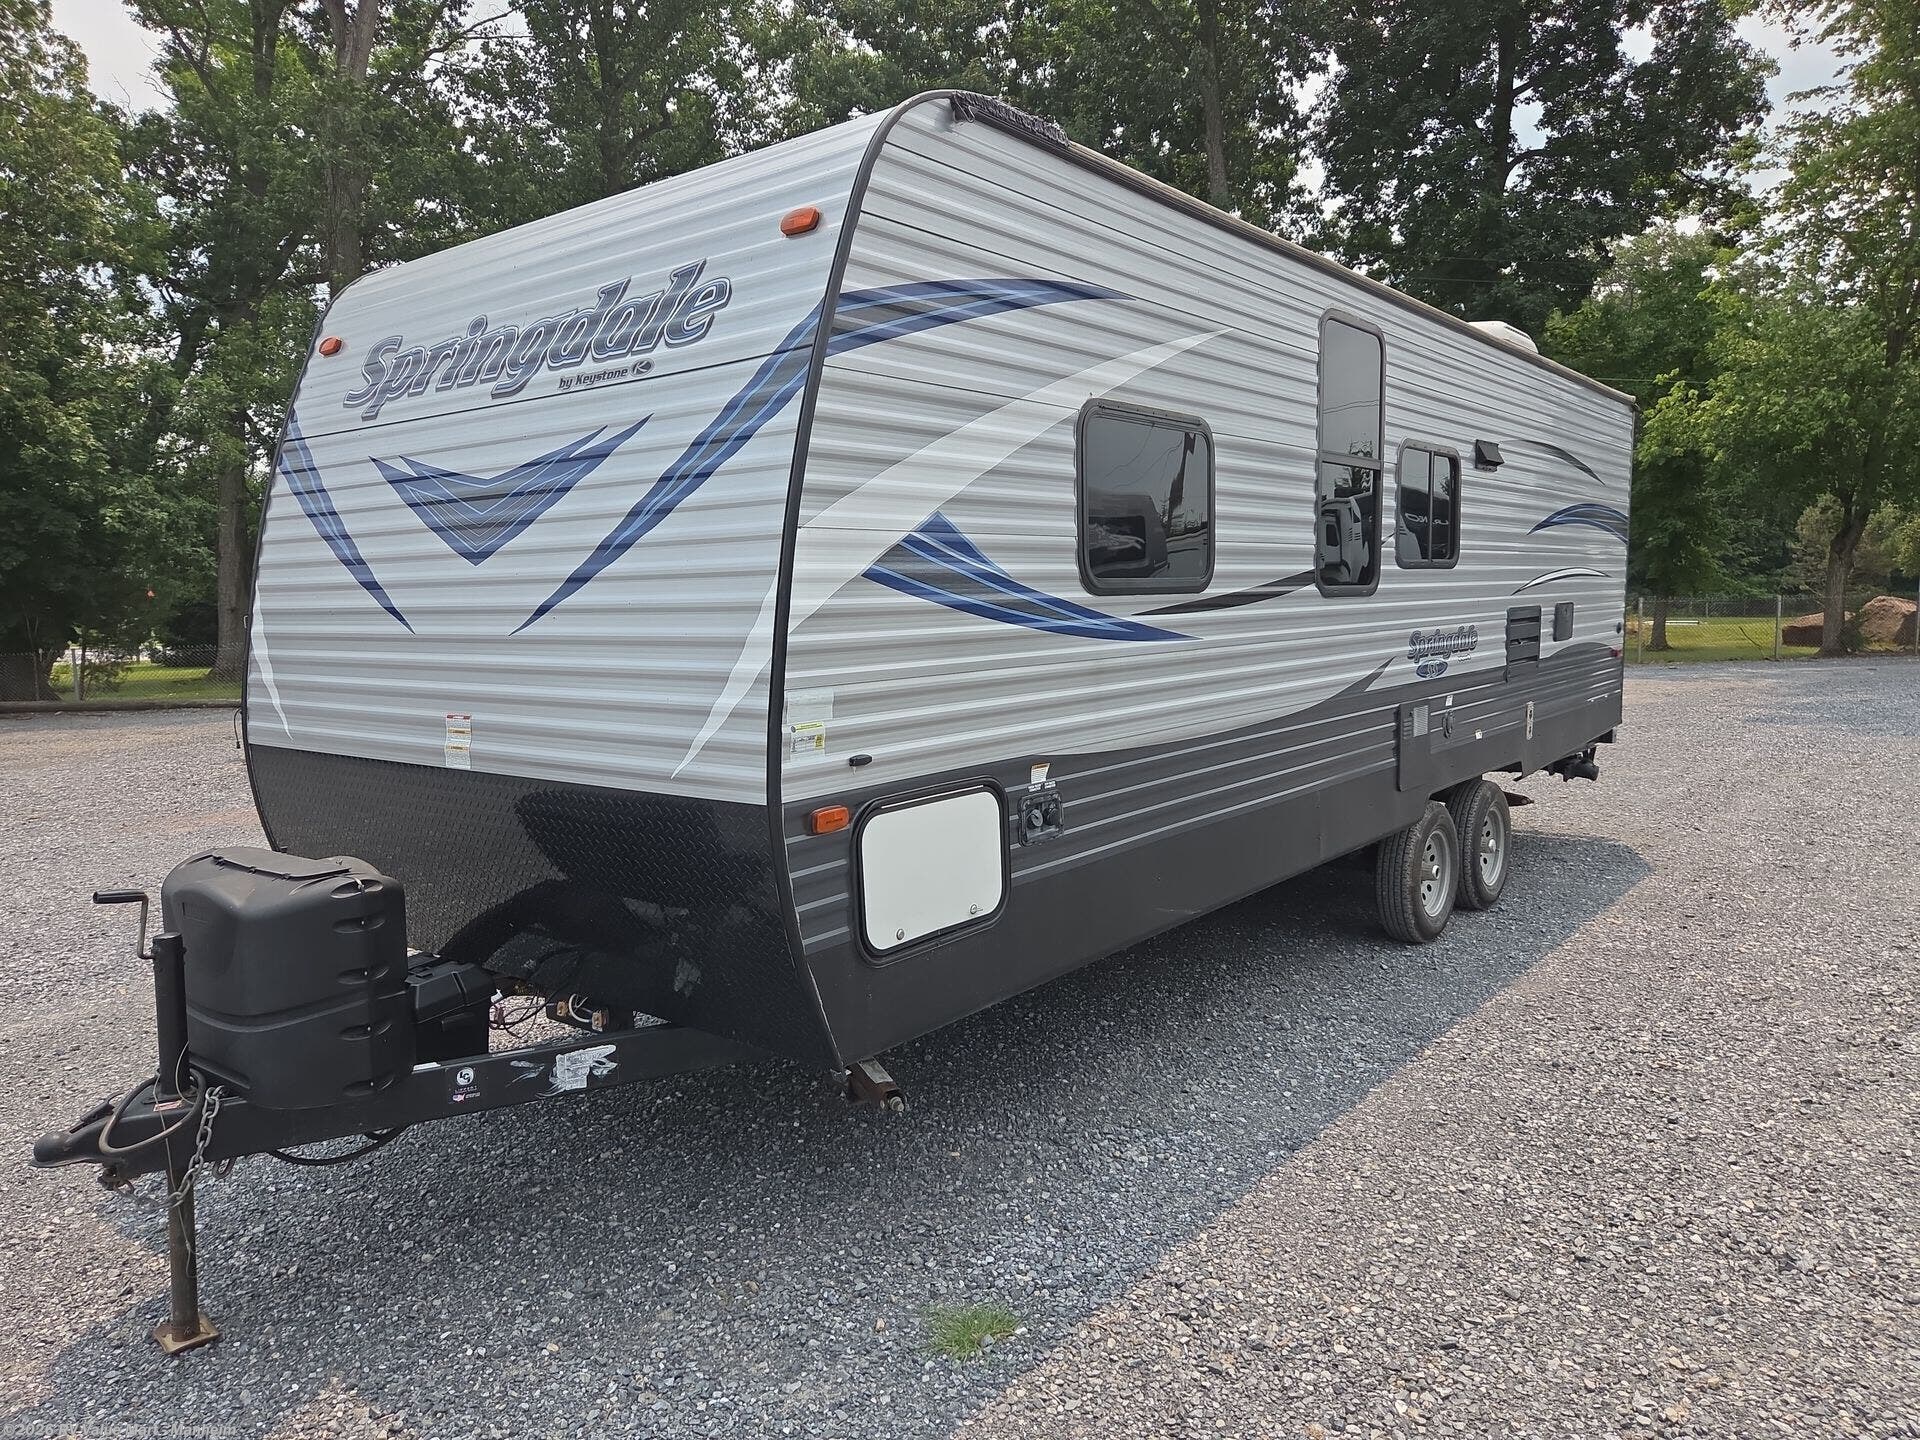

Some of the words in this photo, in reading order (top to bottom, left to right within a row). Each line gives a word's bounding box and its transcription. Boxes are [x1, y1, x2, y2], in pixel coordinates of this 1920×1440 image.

[343, 258, 732, 421] Springdale
[558, 377, 572, 390] by
[575, 368, 628, 386] Keystone
[1407, 625, 1478, 664] Springdale
